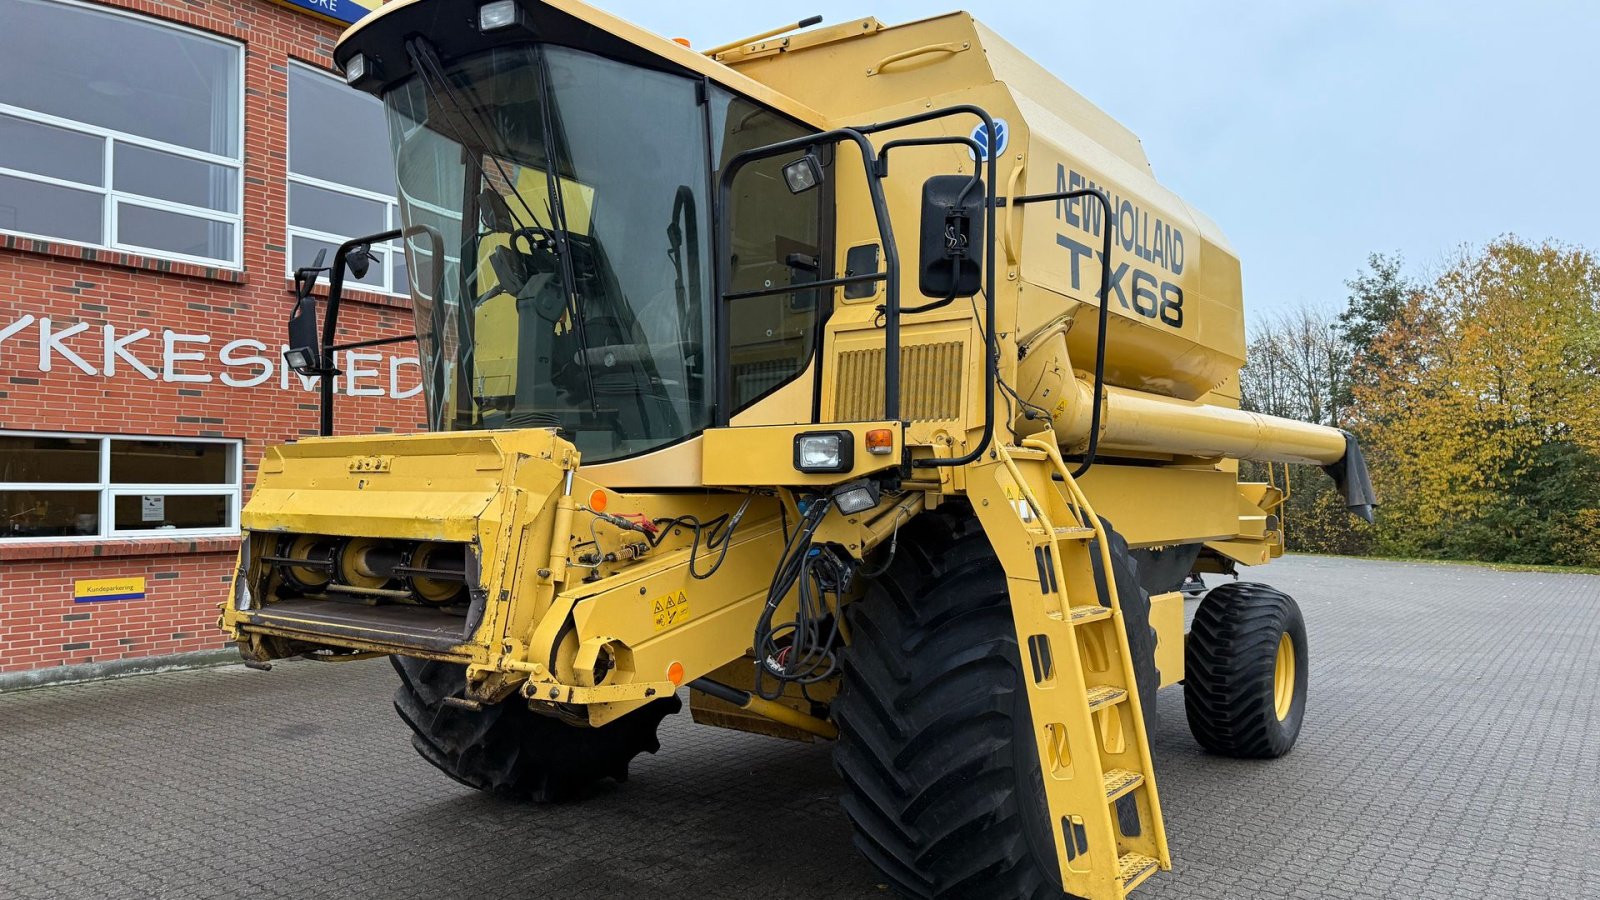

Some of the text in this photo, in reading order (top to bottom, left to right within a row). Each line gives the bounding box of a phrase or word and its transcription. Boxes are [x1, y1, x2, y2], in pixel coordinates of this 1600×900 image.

[1056, 163, 1184, 275] NEW HOLLAND
[1056, 233, 1184, 329] TX68
[86, 585, 134, 593] Kundeparkering
